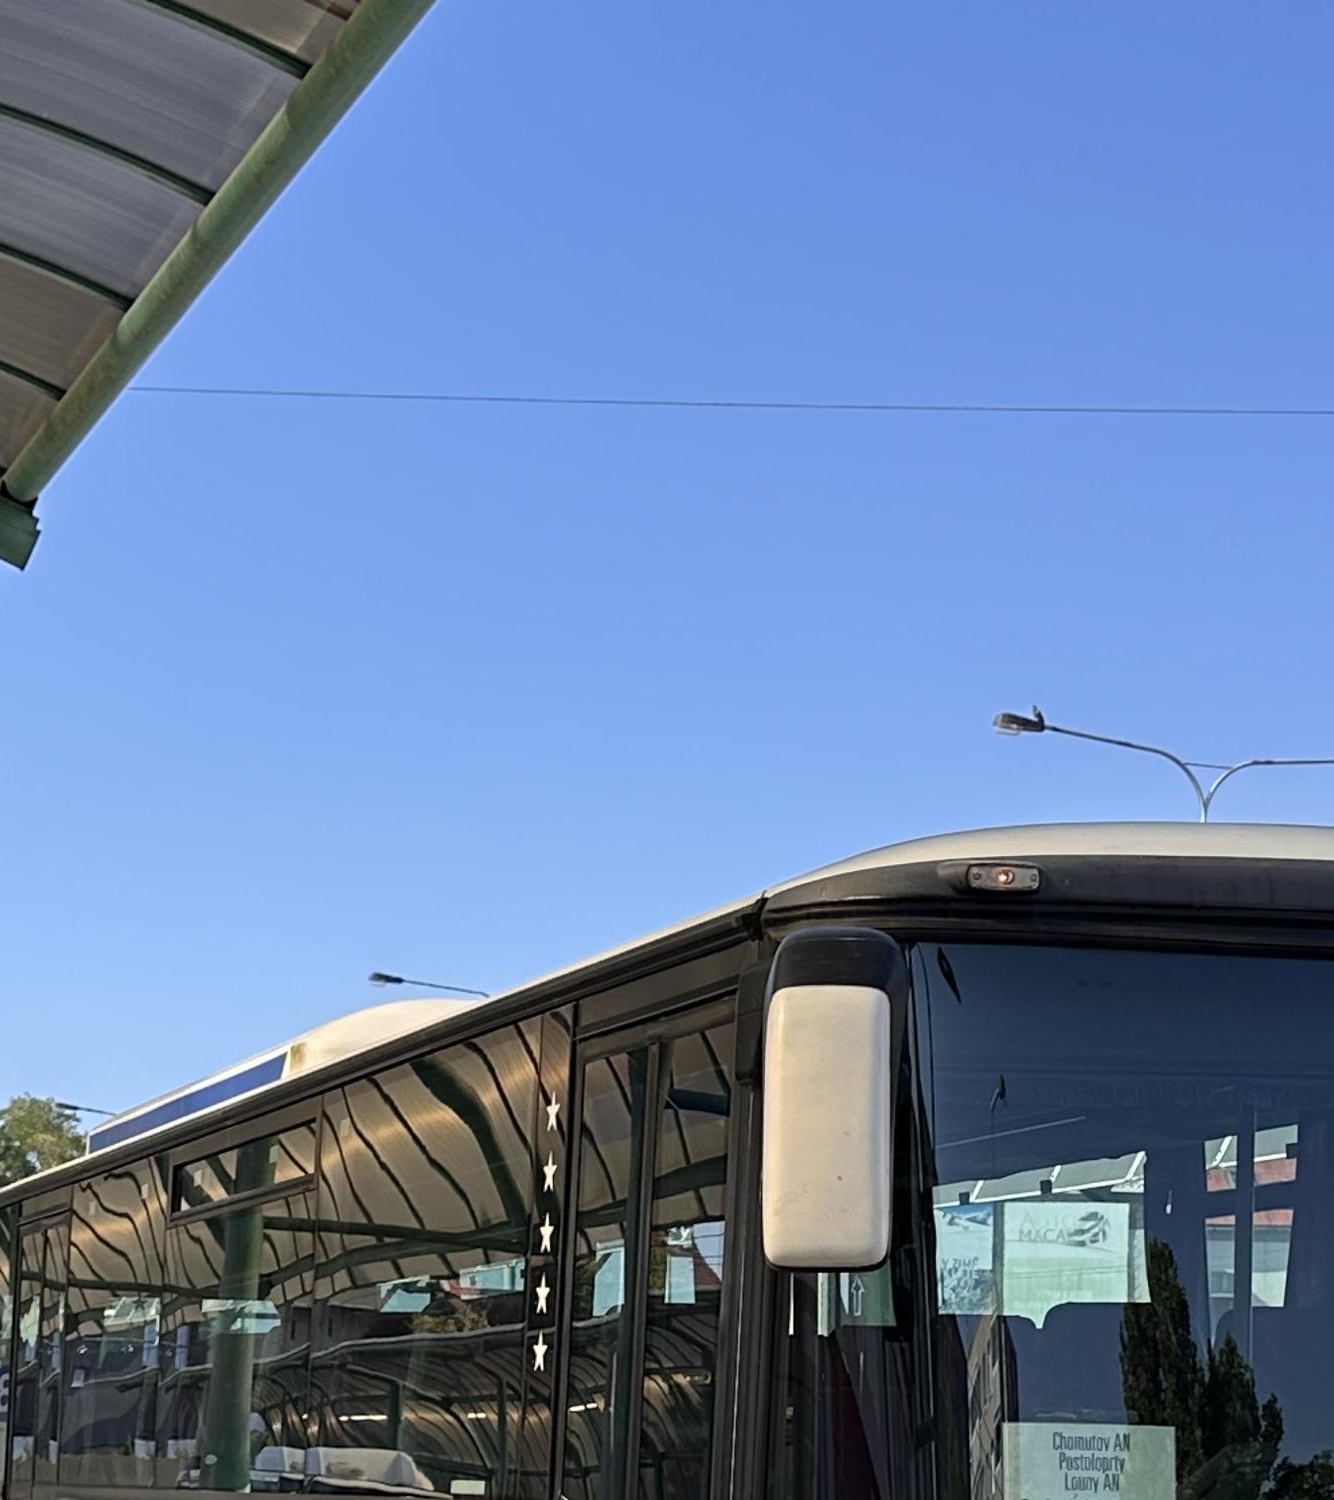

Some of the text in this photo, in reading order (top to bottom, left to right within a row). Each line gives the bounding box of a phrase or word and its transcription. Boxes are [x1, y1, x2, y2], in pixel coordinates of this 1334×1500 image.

[1052, 1431, 1132, 1452] Chomutov AN
[1059, 1452, 1126, 1474] Postoloprty
[1064, 1472, 1120, 1493] Louny AN
